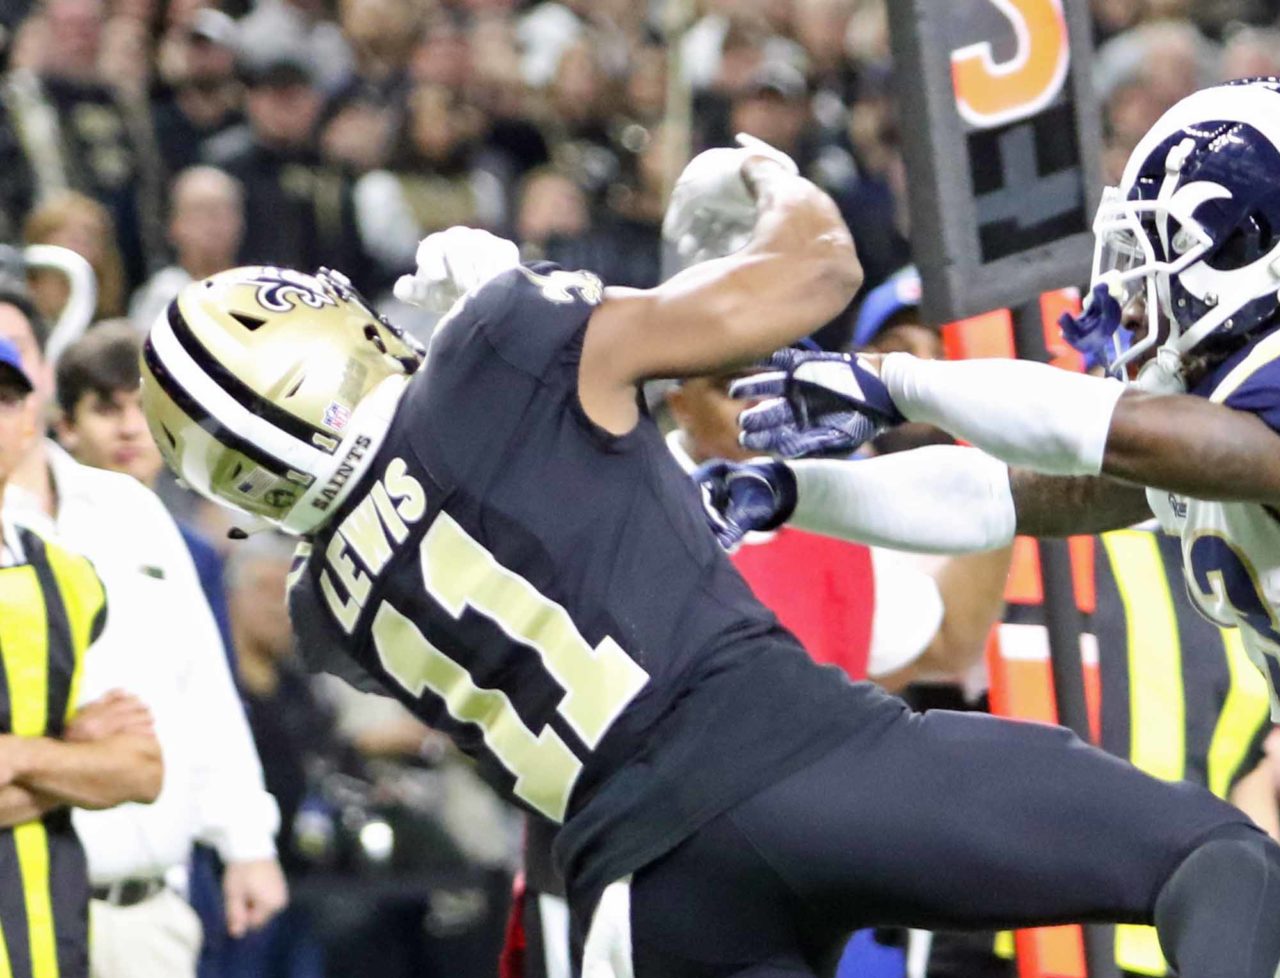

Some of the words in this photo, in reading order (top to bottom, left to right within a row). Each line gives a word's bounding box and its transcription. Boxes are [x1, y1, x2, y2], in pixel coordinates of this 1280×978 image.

[312, 436, 372, 510] SAINTS
[320, 458, 427, 635] LEWIS
[372, 510, 651, 824] 11
